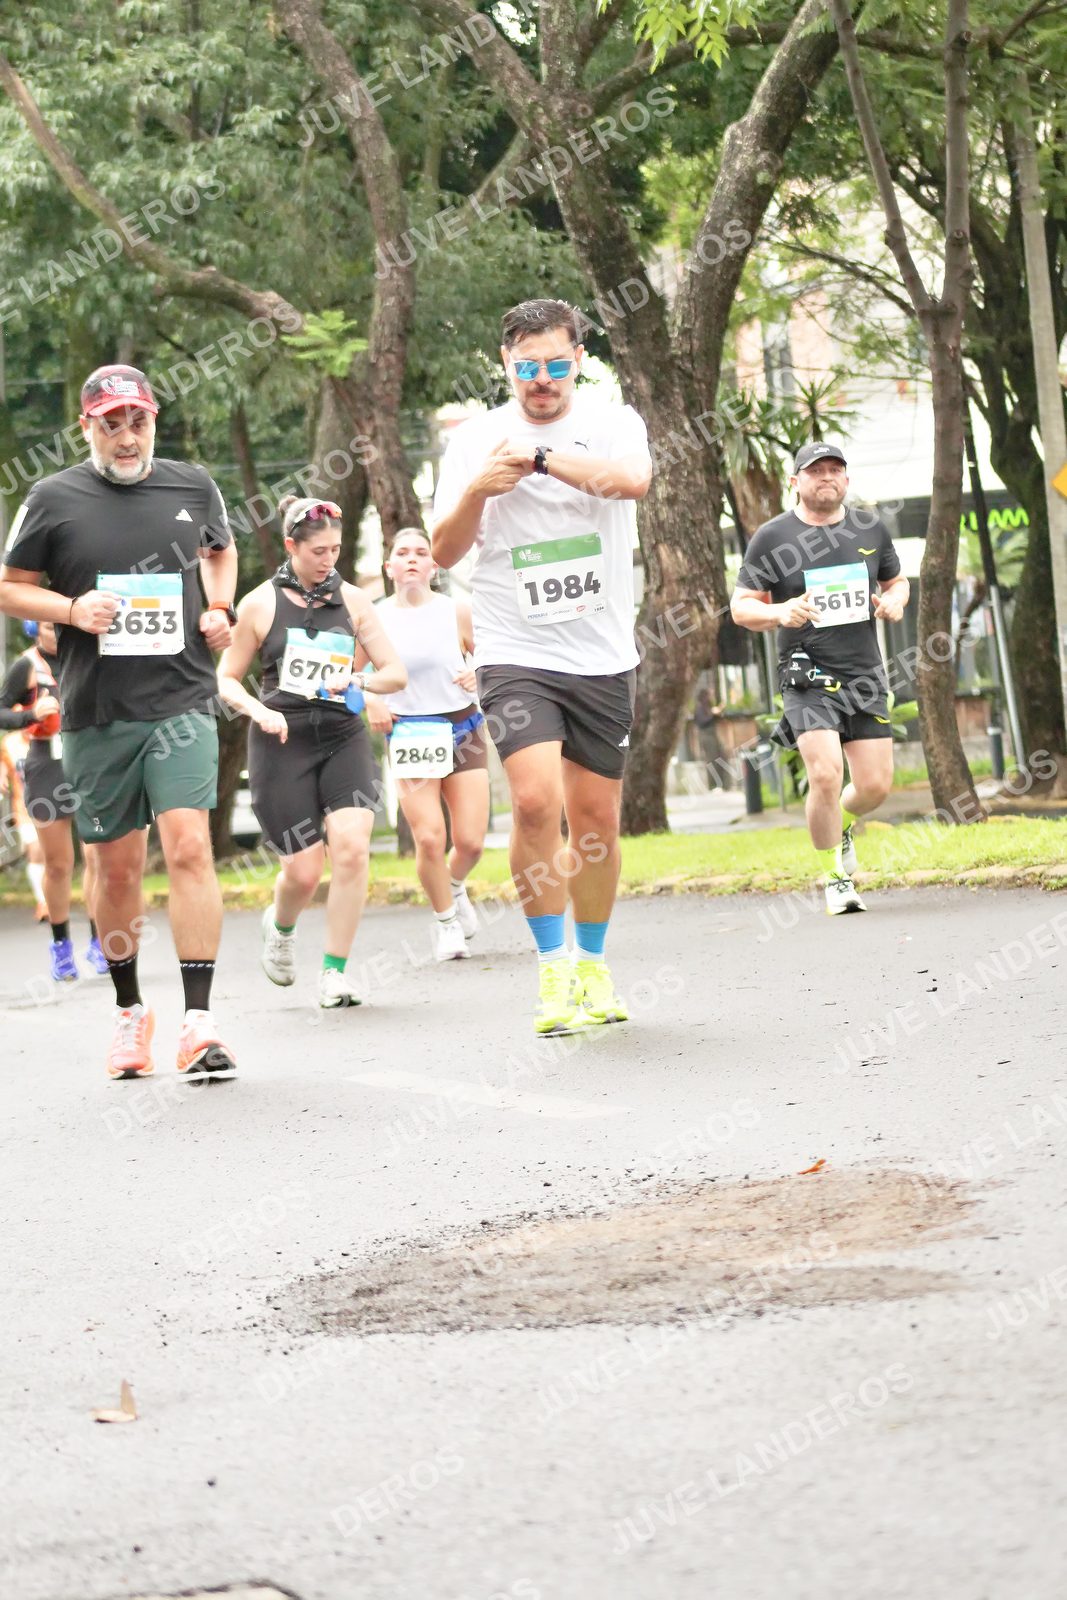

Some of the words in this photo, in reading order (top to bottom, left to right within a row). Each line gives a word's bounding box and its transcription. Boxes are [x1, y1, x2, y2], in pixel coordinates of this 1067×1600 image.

[524, 571, 601, 606] 1984
[814, 590, 866, 612] 5615
[108, 611, 178, 635] 3633
[289, 658, 344, 681] 670
[396, 747, 447, 764] 2849
